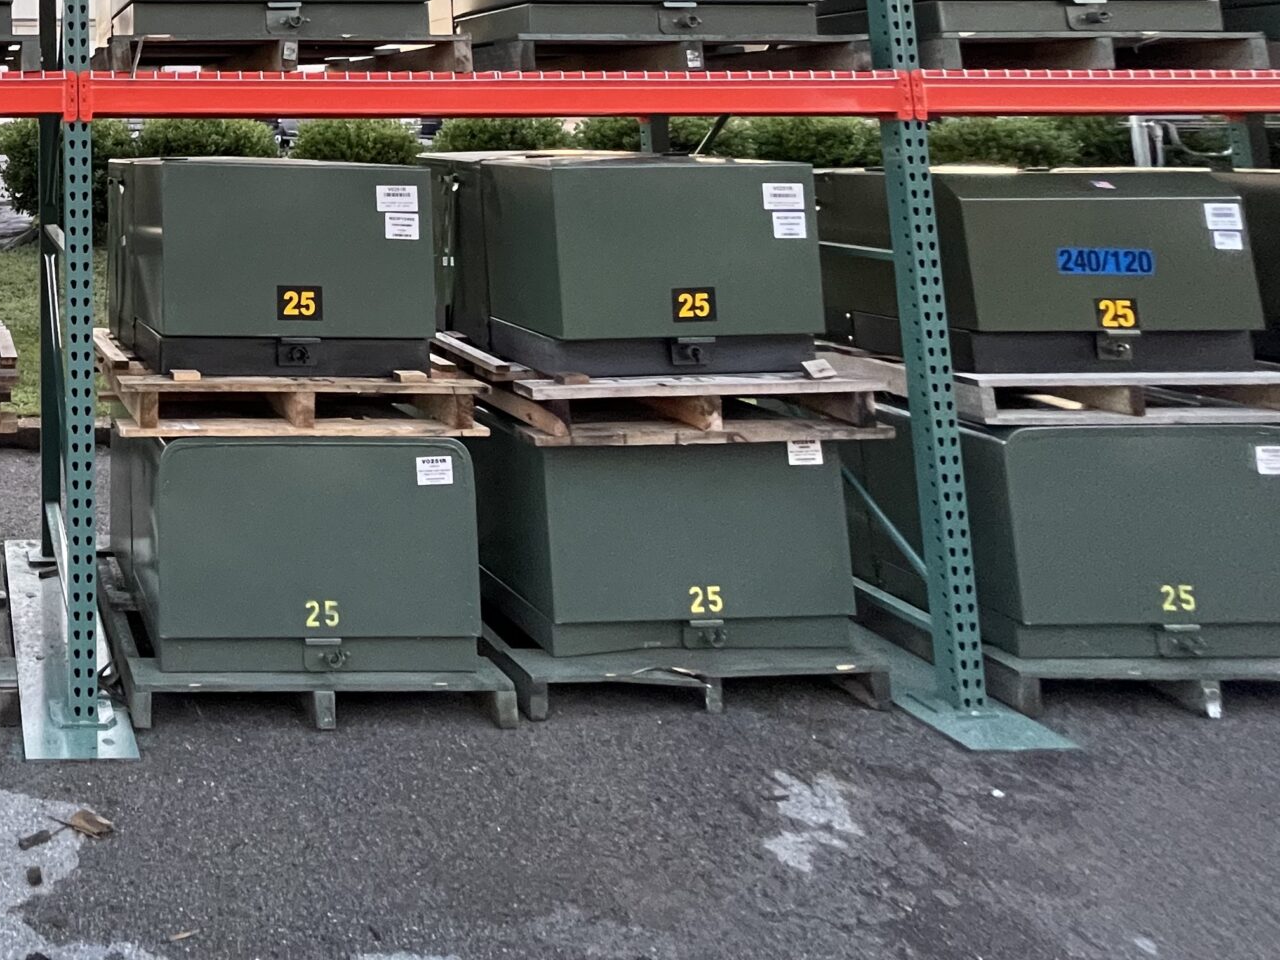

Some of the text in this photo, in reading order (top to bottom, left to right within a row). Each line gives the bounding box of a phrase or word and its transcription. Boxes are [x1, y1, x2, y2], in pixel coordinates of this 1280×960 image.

[1059, 249, 1153, 273] 240/120
[284, 291, 315, 316] 25
[678, 293, 710, 317] 25
[1099, 300, 1135, 327] 25
[690, 586, 723, 614] 25
[1161, 583, 1196, 612] 25
[305, 599, 339, 628] 25
